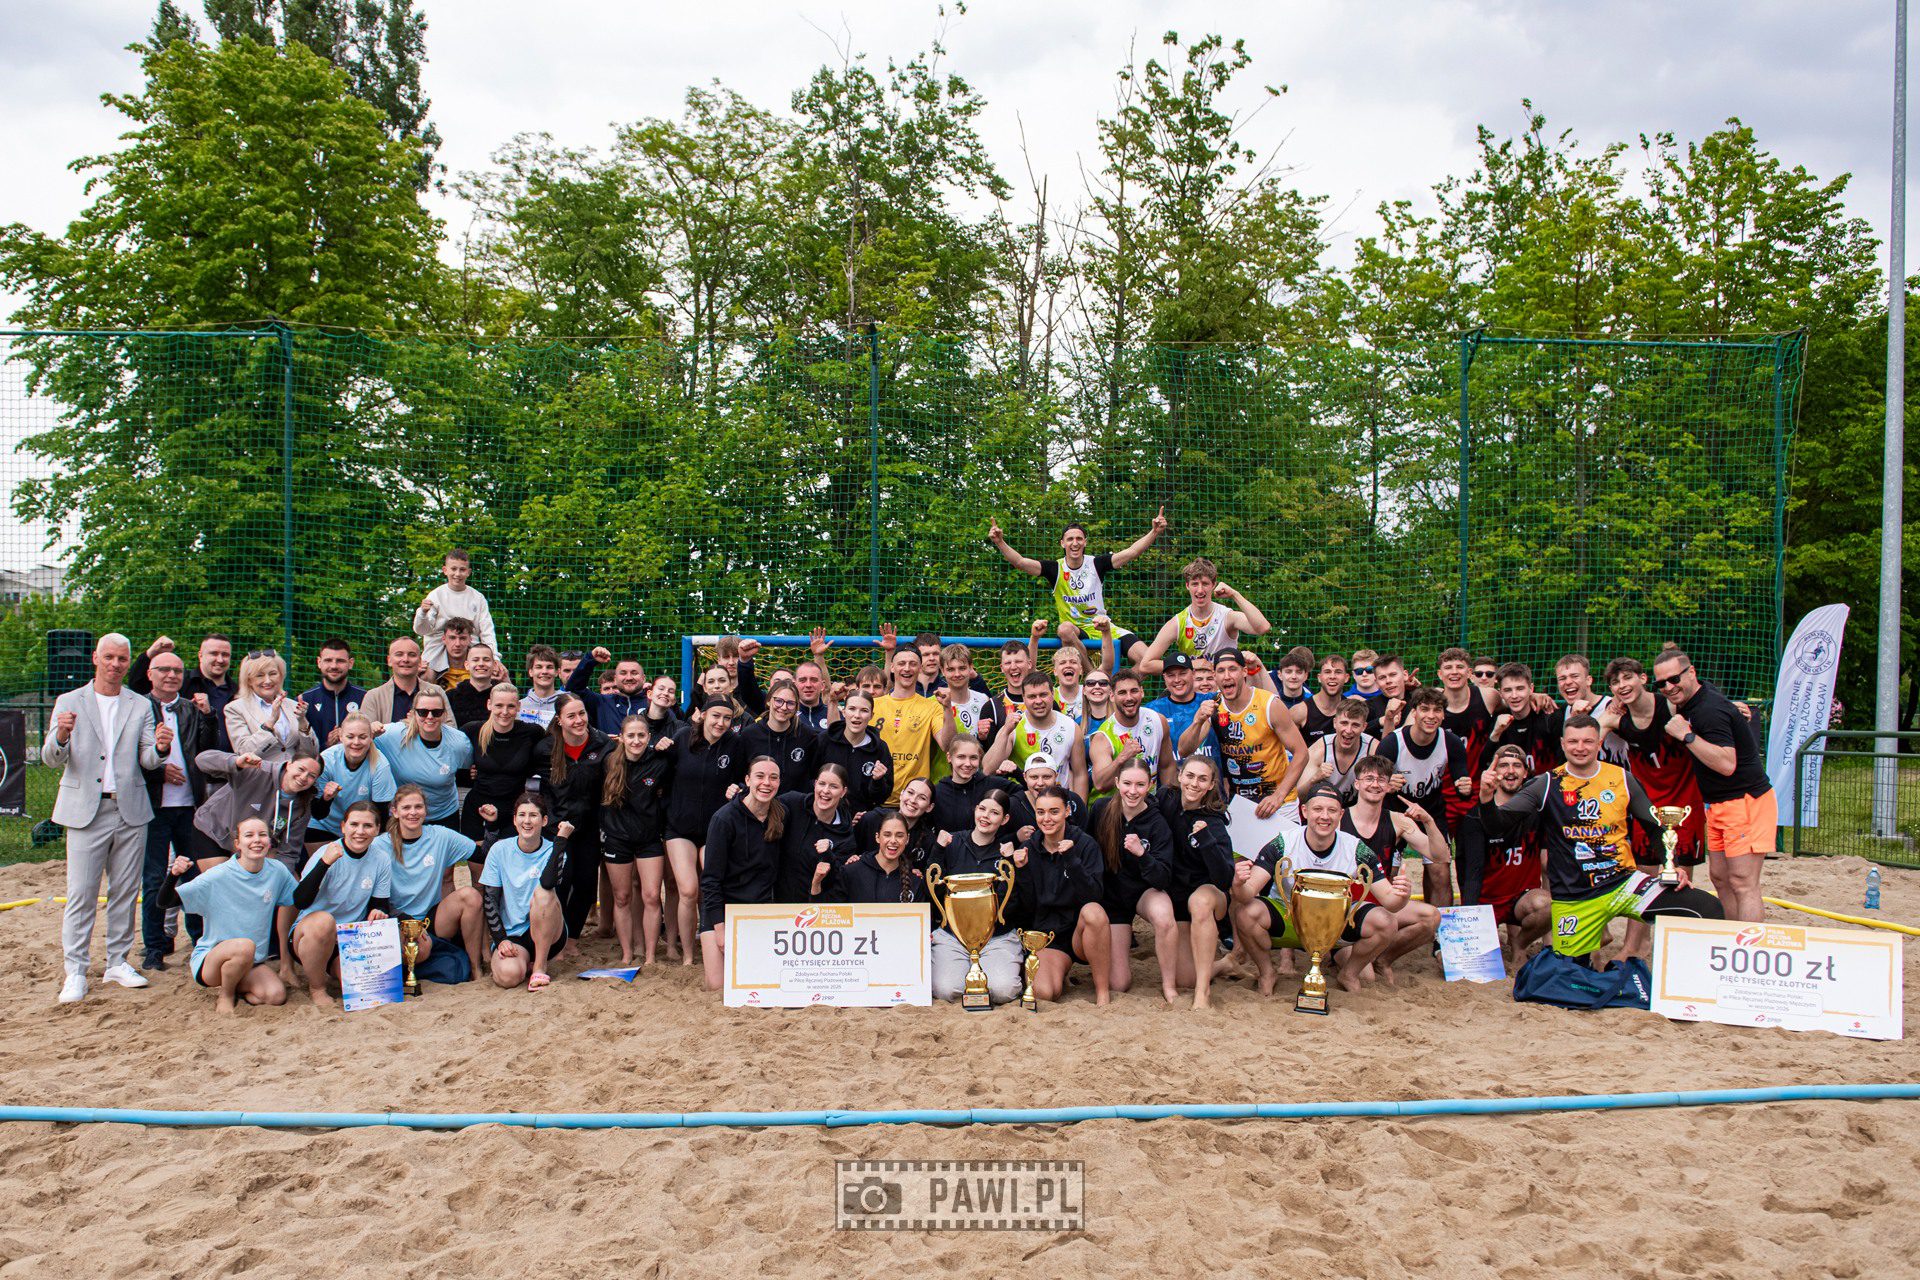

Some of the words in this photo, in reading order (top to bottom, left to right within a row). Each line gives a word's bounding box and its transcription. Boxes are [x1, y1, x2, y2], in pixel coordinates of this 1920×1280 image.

[1070, 576, 1084, 590] 66
[1063, 593, 1096, 603] PANAWIT
[1193, 633, 1208, 650] 13
[960, 710, 972, 728] 9
[1783, 679, 1802, 766] STOWARZYSZENIE
[1041, 737, 1052, 755] 6
[1416, 781, 1425, 798] 8
[1577, 797, 1600, 820] 12
[1505, 846, 1523, 866] 15
[1557, 915, 1578, 937] 12
[354, 931, 383, 940] DYPLOM
[773, 930, 843, 956] 5000
[853, 930, 880, 955] zł
[782, 958, 799, 967] PIĘĆ
[800, 959, 831, 968] TYSIĘCY
[1709, 945, 1793, 978] 5000
[1805, 955, 1837, 982] zł
[1719, 974, 1741, 984] PIĘĆ
[1741, 976, 1777, 987] TYSIĘCY
[1778, 980, 1818, 990] ZŁOTYCH
